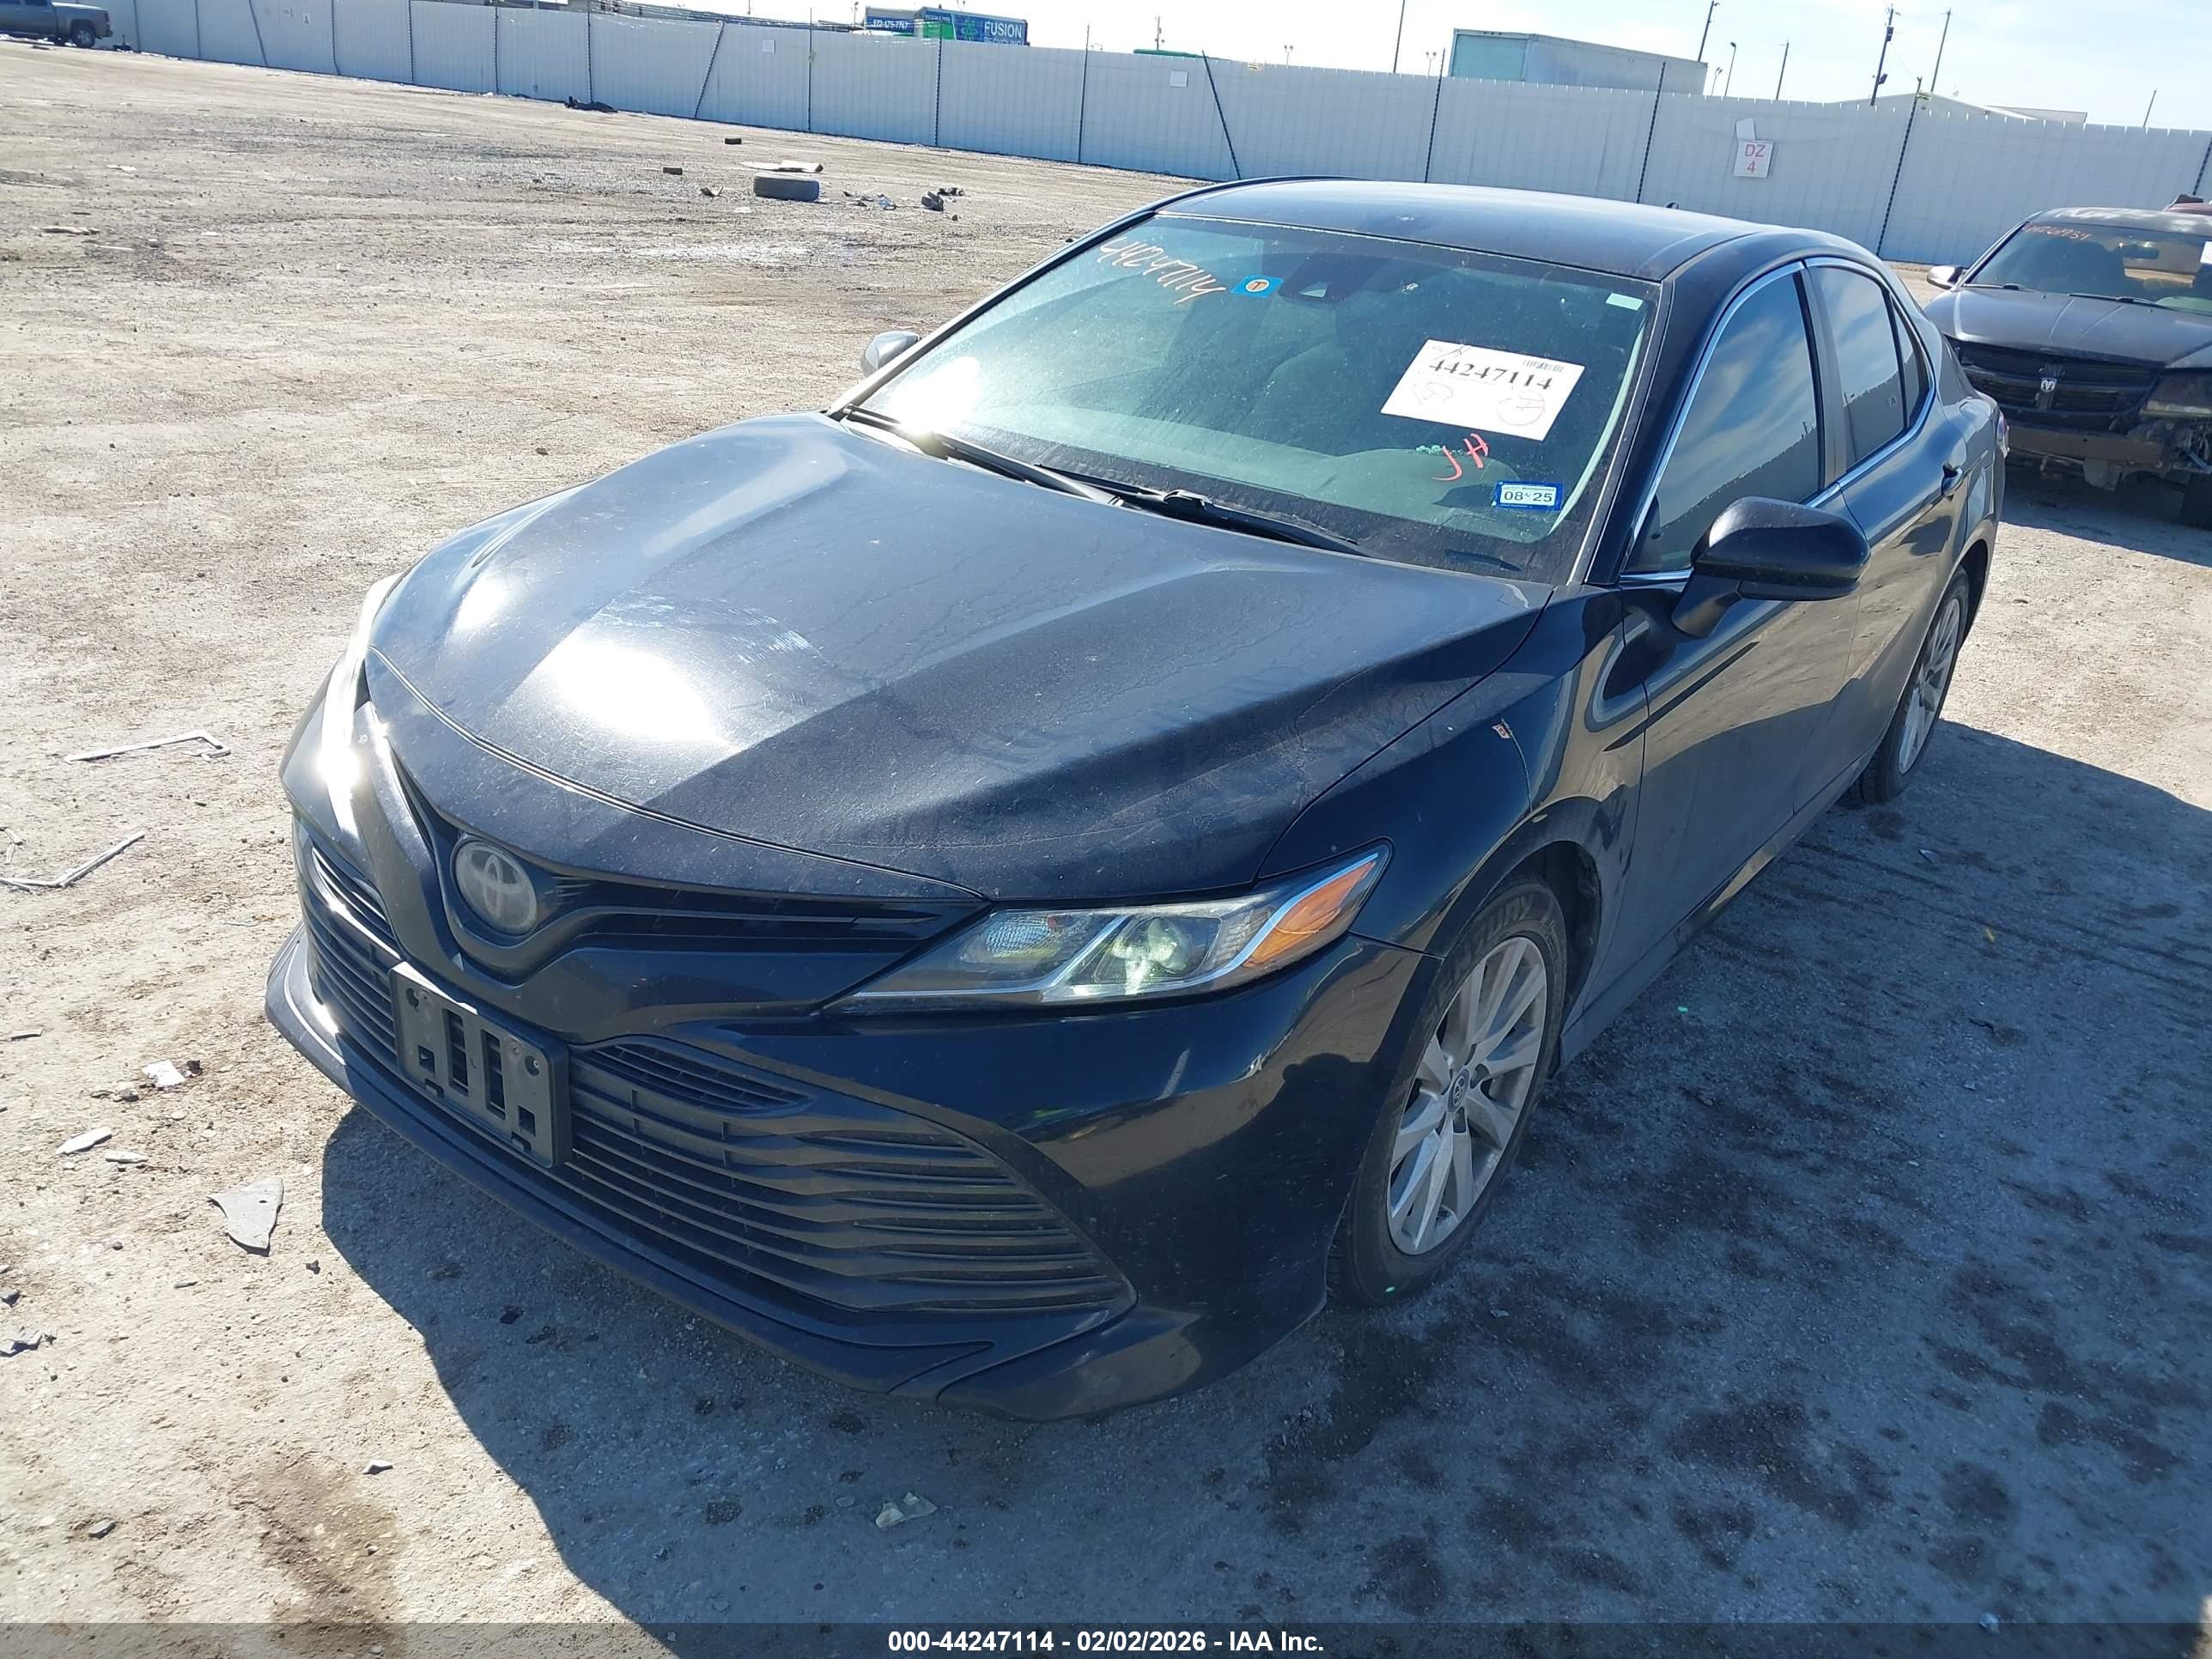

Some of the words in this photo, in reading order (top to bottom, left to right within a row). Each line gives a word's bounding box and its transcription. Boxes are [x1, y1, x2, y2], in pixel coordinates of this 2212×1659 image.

[984, 21, 1022, 38] FUSION
[1744, 144, 1766, 157] DZ
[1747, 161, 1756, 173] 4
[1428, 359, 1553, 390] 44247114
[1504, 491, 1523, 501] 08
[1533, 492, 1553, 502] 25
